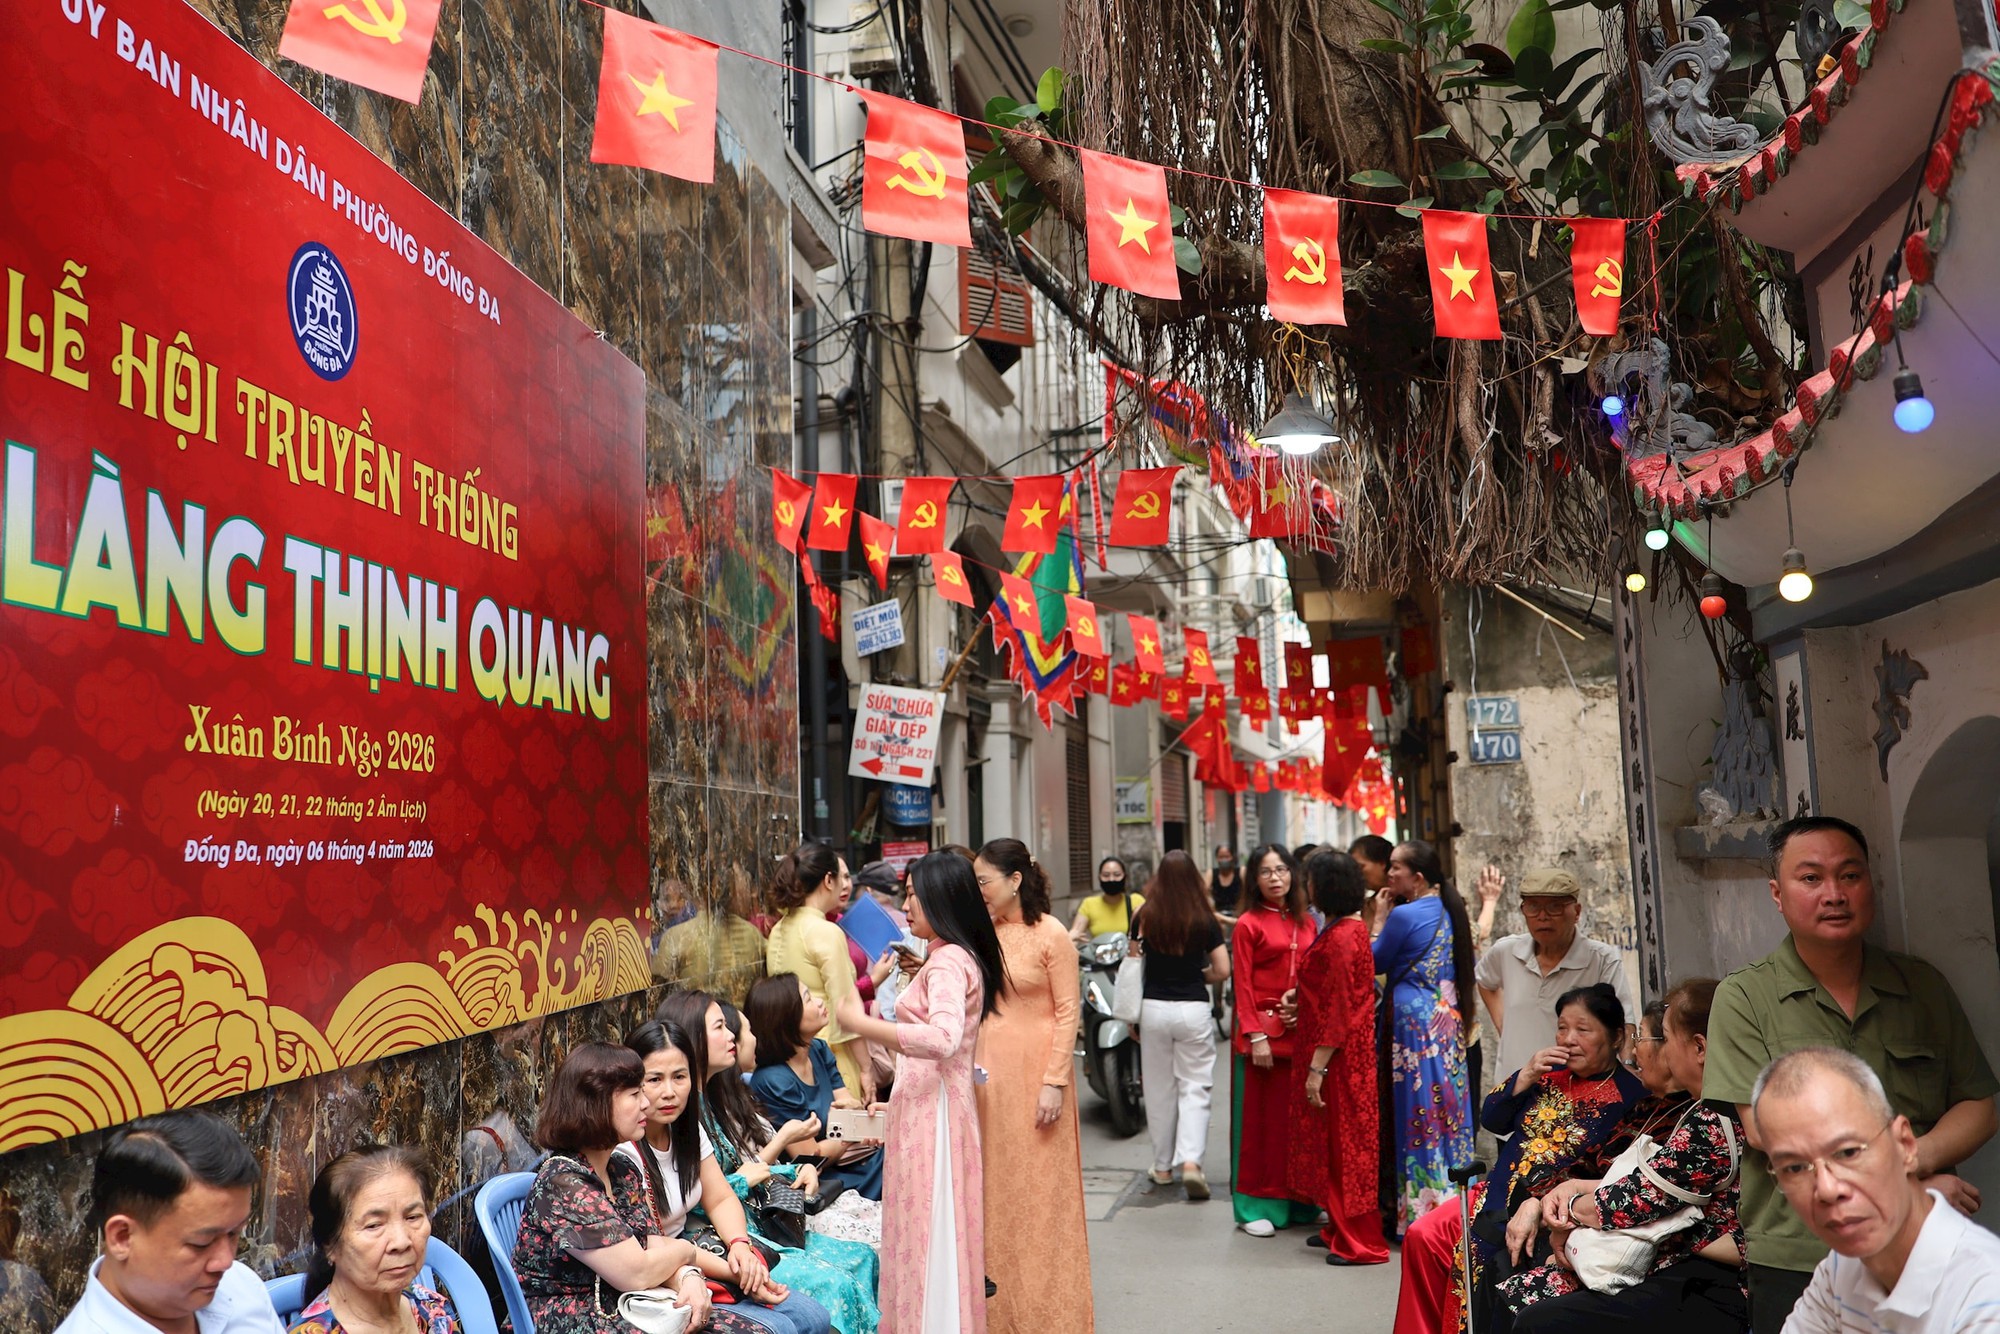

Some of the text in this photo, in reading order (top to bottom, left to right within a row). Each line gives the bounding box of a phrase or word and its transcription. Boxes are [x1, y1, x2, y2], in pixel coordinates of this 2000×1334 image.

[116, 18, 181, 98] BAN
[190, 73, 268, 160] NHÂN
[275, 137, 326, 202] DÂN
[332, 178, 418, 264] PHƯỜNG
[423, 246, 475, 305] ĐỐNG
[479, 286, 501, 325] ĐA
[329, 355, 343, 372] ĐA
[5, 259, 519, 561] LỄ HỘI TRUYỀN THỐNG
[1, 440, 612, 721] LÀNG THỊNH QUANG
[900, 720, 927, 739] DÉP
[1473, 701, 1514, 725] 172
[184, 703, 436, 778] Xuân Bính Ngọ 2026
[916, 748, 933, 760] 221
[1476, 735, 1517, 759] 170
[197, 790, 427, 823] (Ngày 20, 21, 22 tháng 2 Âm Lịch)
[184, 835, 434, 869] Đống Đa, ngày 06 tháng 4 năm 2026
